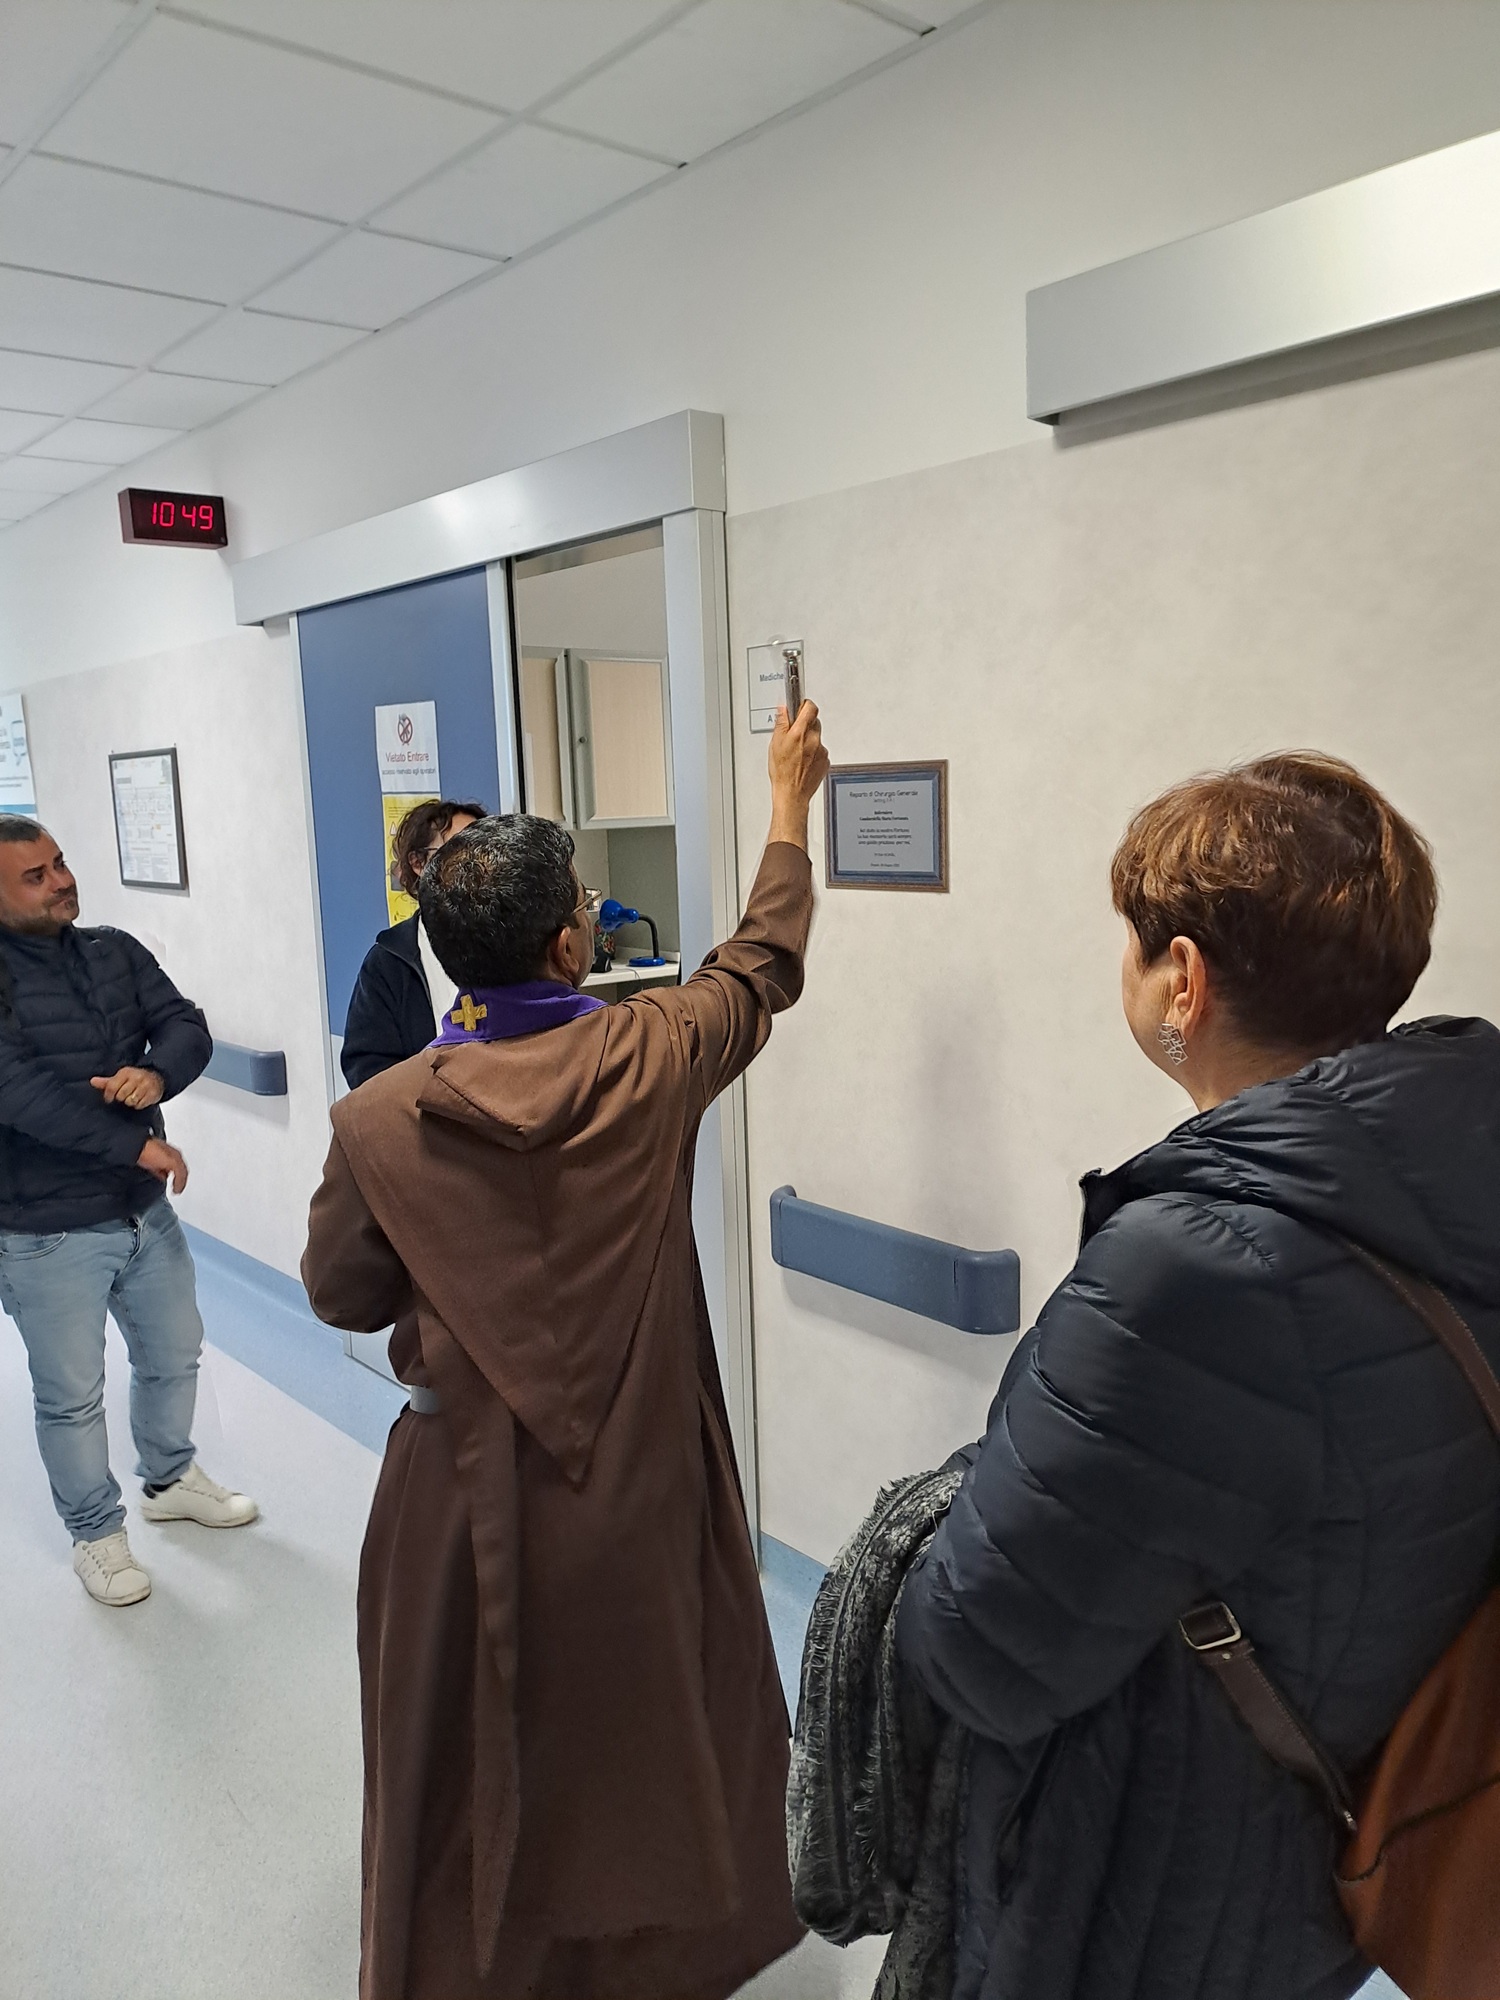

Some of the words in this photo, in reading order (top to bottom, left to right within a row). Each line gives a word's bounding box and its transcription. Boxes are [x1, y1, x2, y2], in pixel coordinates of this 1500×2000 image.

[152, 502, 175, 527] 10
[181, 505, 213, 530] 49
[385, 752, 406, 762] Vietato
[407, 751, 429, 762] Entrare
